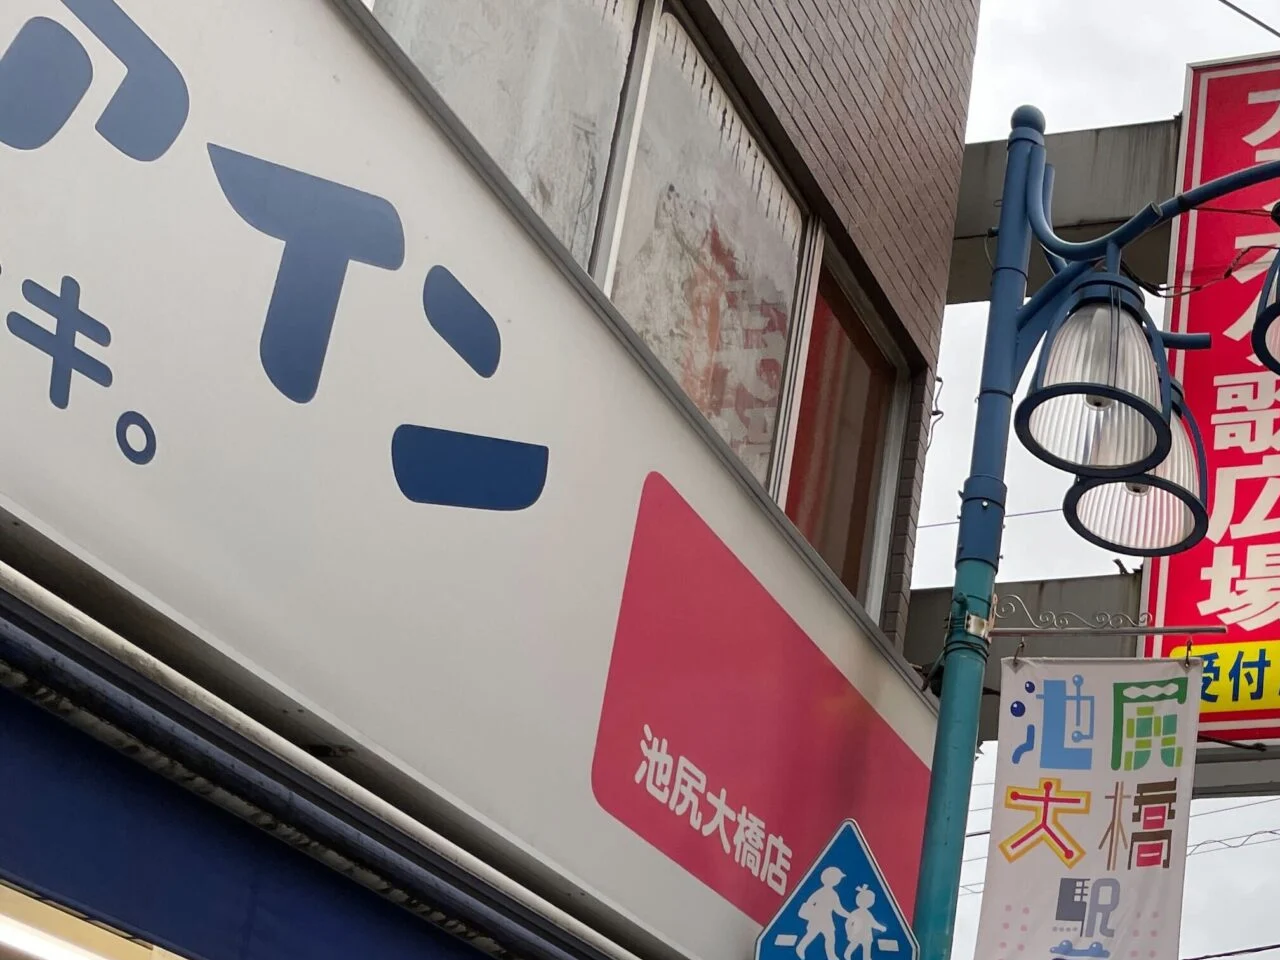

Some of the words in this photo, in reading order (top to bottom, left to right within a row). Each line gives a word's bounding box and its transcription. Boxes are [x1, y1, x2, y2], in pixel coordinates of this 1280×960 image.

[634, 724, 793, 897] 池尻大橋店
[998, 777, 1177, 871] 大橋
